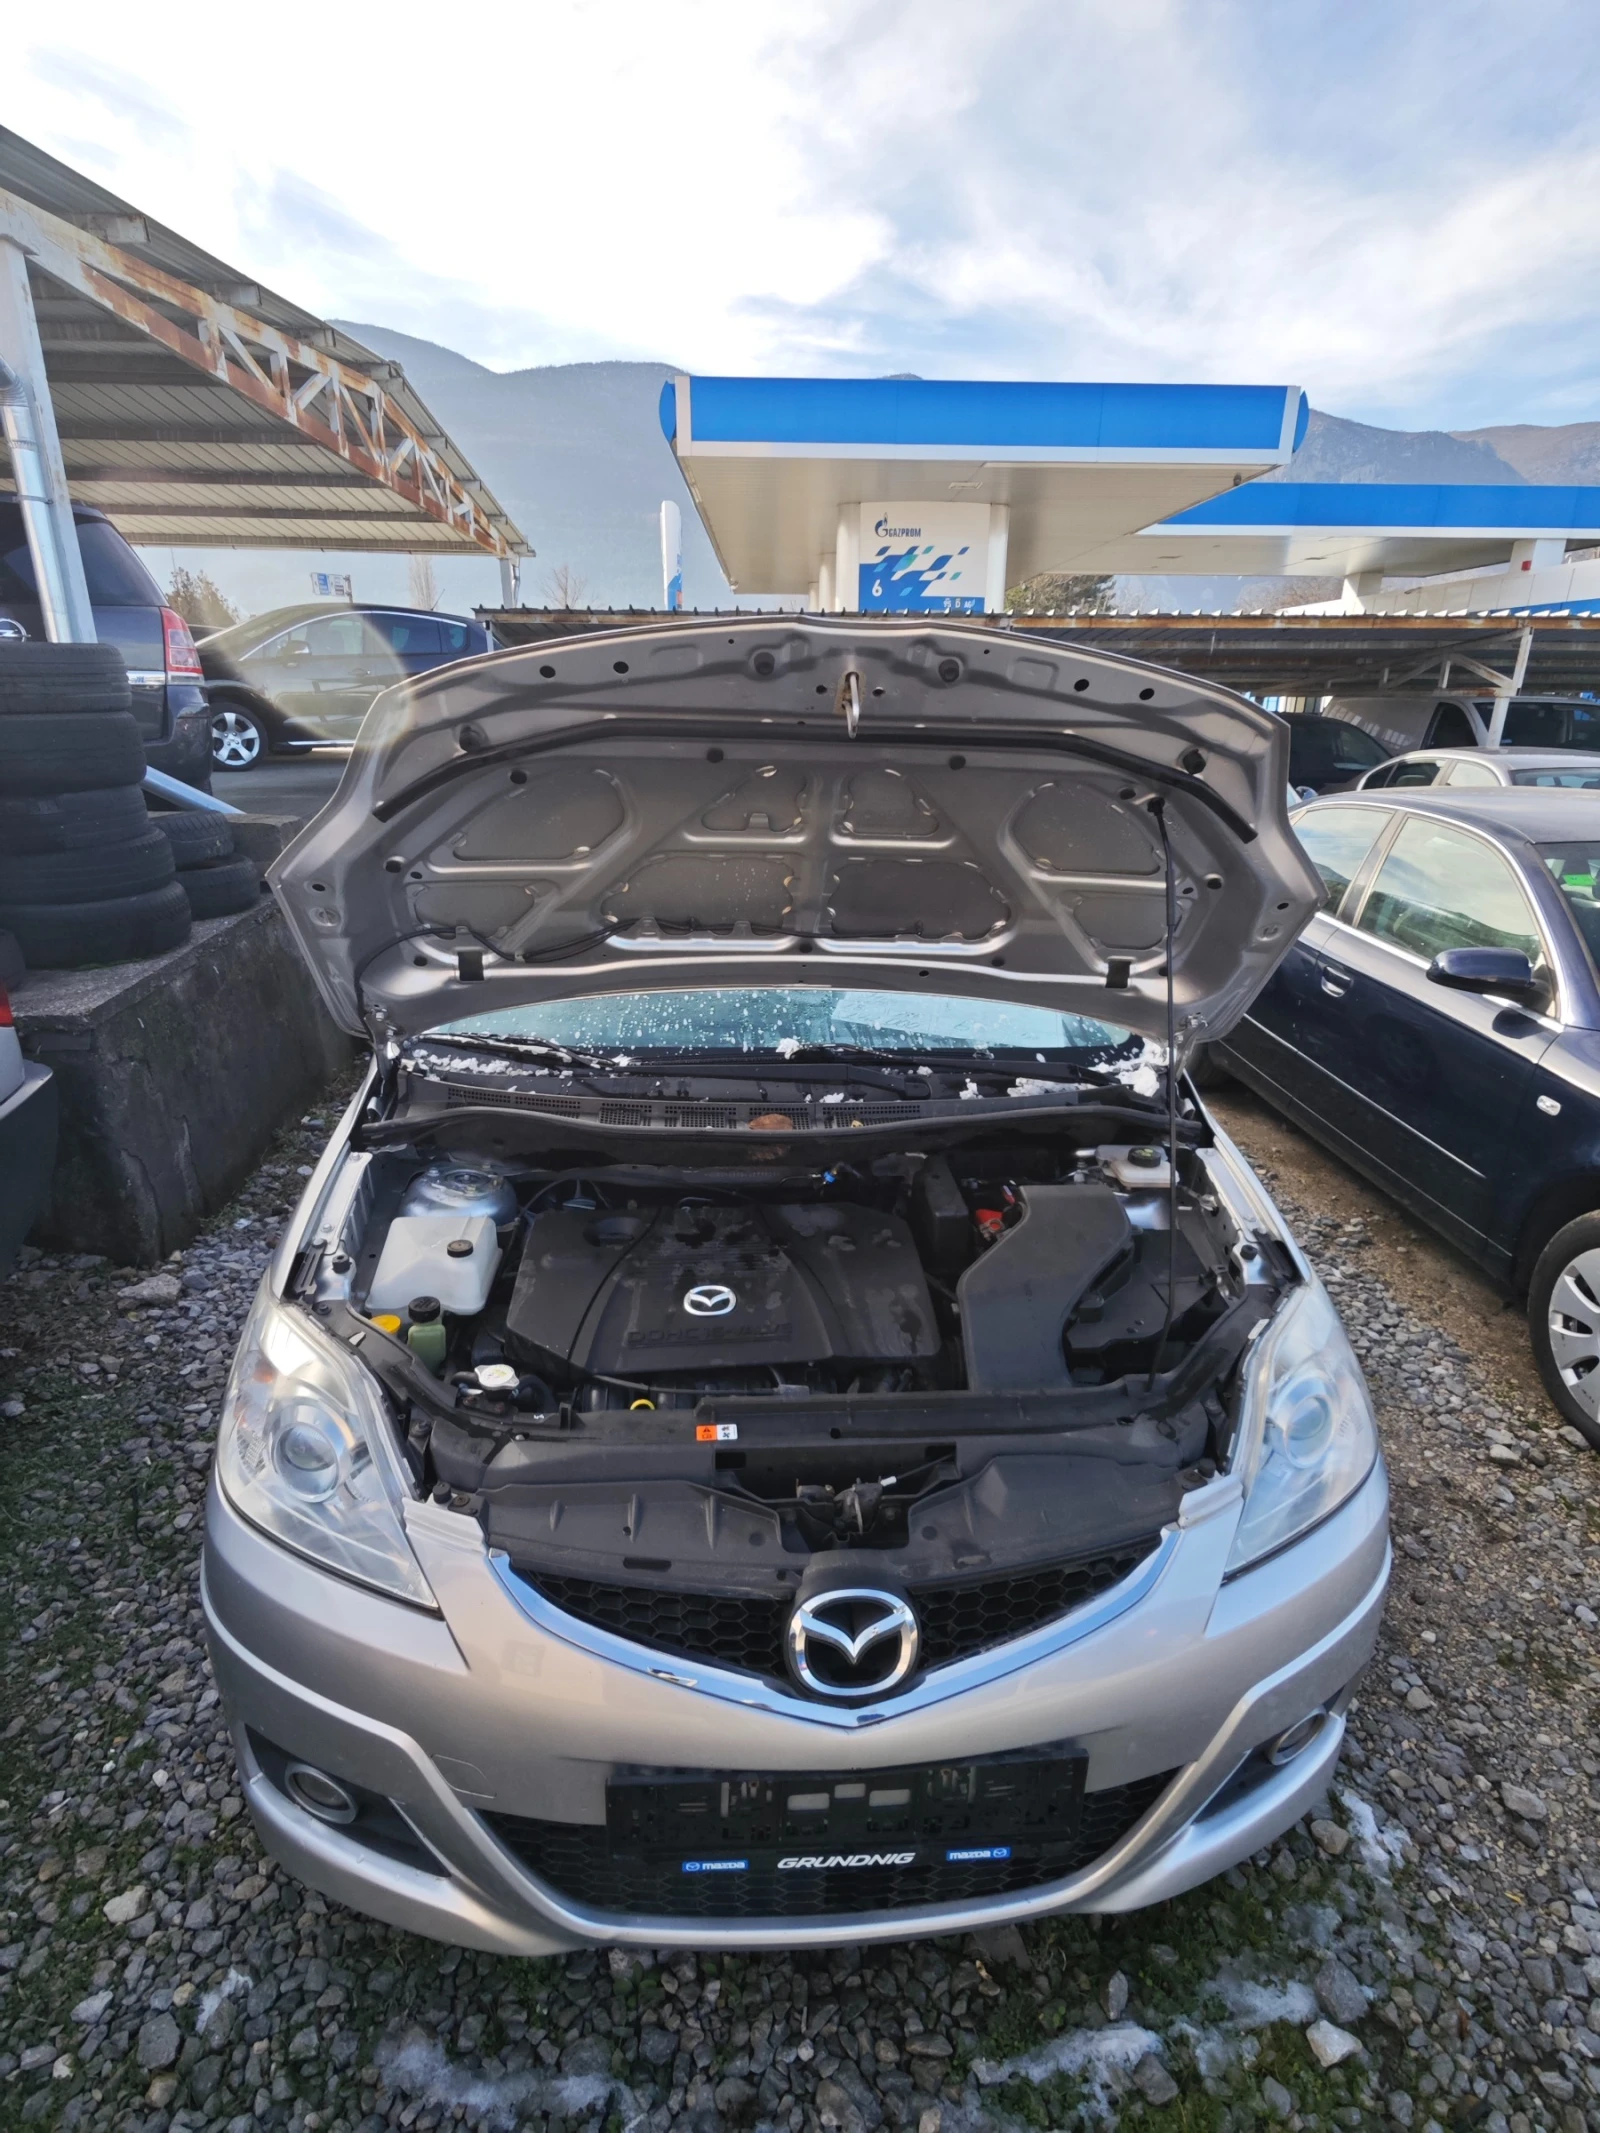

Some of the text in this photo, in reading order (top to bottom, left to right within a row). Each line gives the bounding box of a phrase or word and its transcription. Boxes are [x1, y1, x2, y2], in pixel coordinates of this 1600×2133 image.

[888, 528, 921, 538] GAZPROM
[872, 579, 883, 597] 6
[777, 1852, 916, 1869] GRUNDNIG
